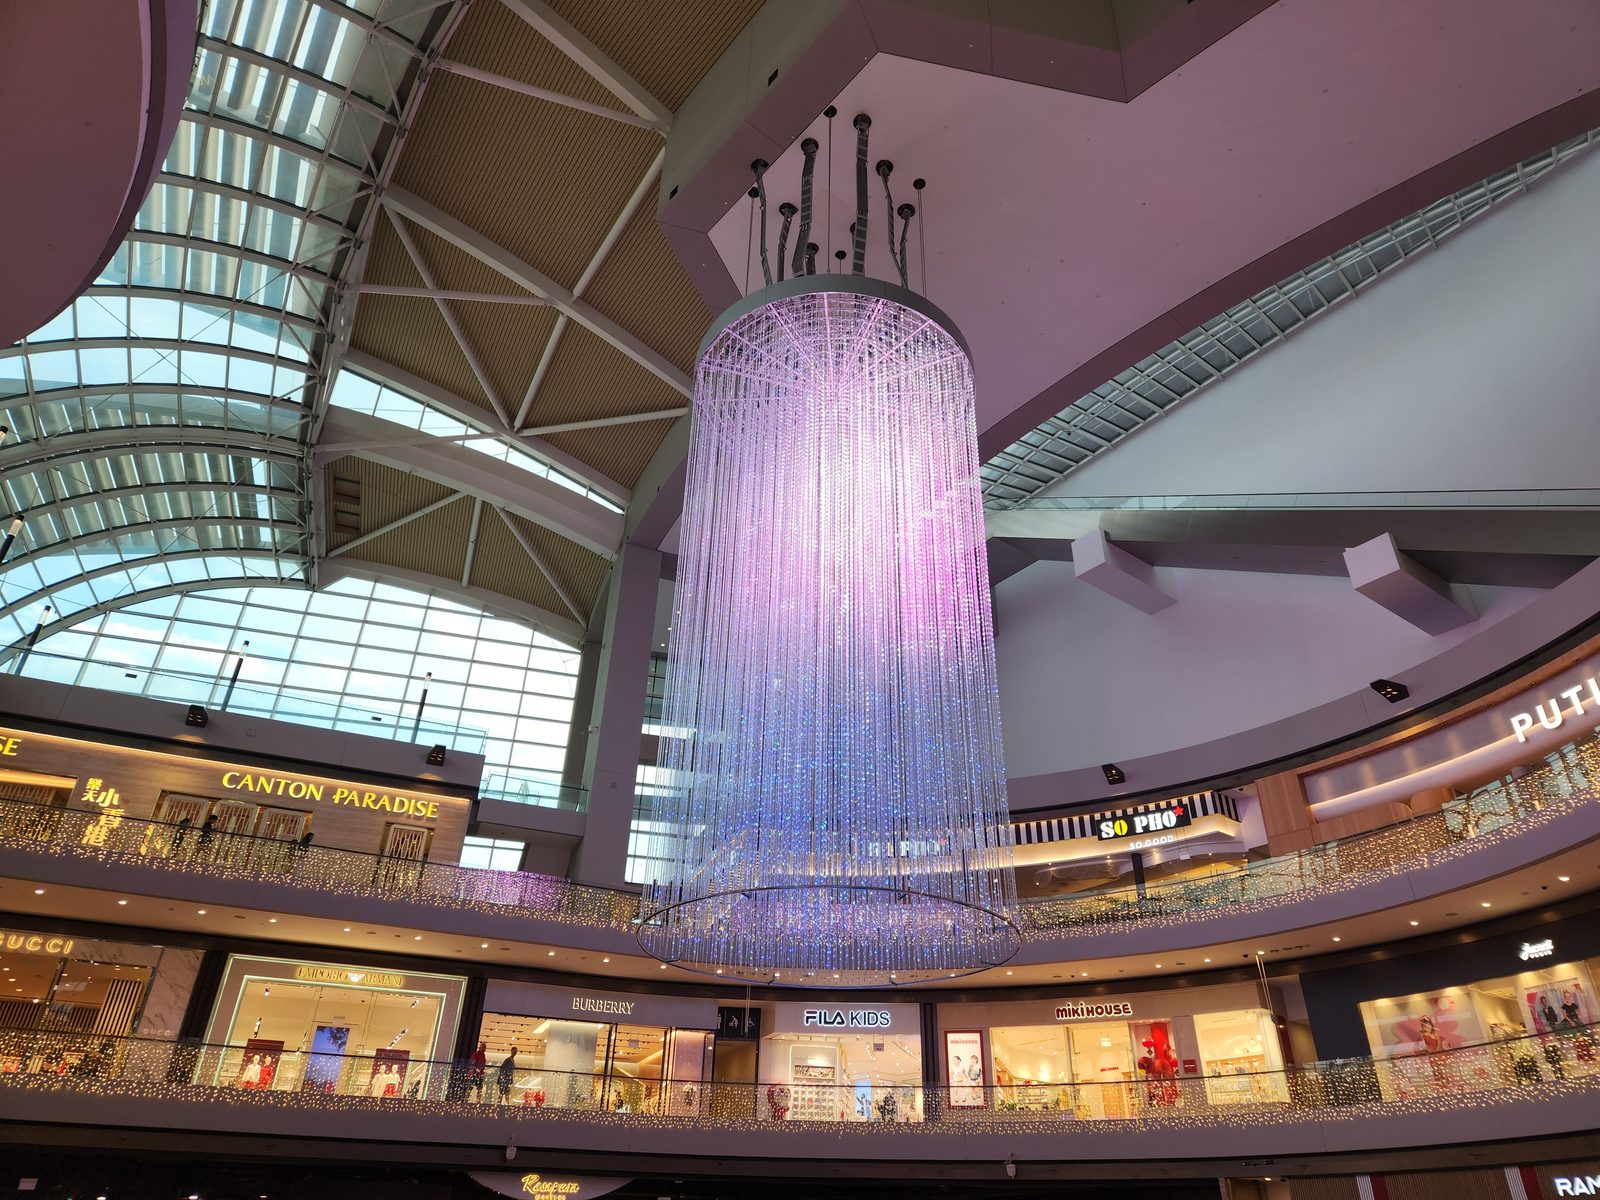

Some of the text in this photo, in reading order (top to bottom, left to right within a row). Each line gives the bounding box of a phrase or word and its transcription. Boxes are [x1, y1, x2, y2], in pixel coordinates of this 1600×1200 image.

[222, 771, 439, 819] CANTON PARADISE
[1100, 810, 1177, 839] SO PHO
[298, 967, 403, 986] EMPORIO ARMANI
[572, 997, 635, 1015] BURBERRY
[804, 1009, 891, 1028] FILA KIDS
